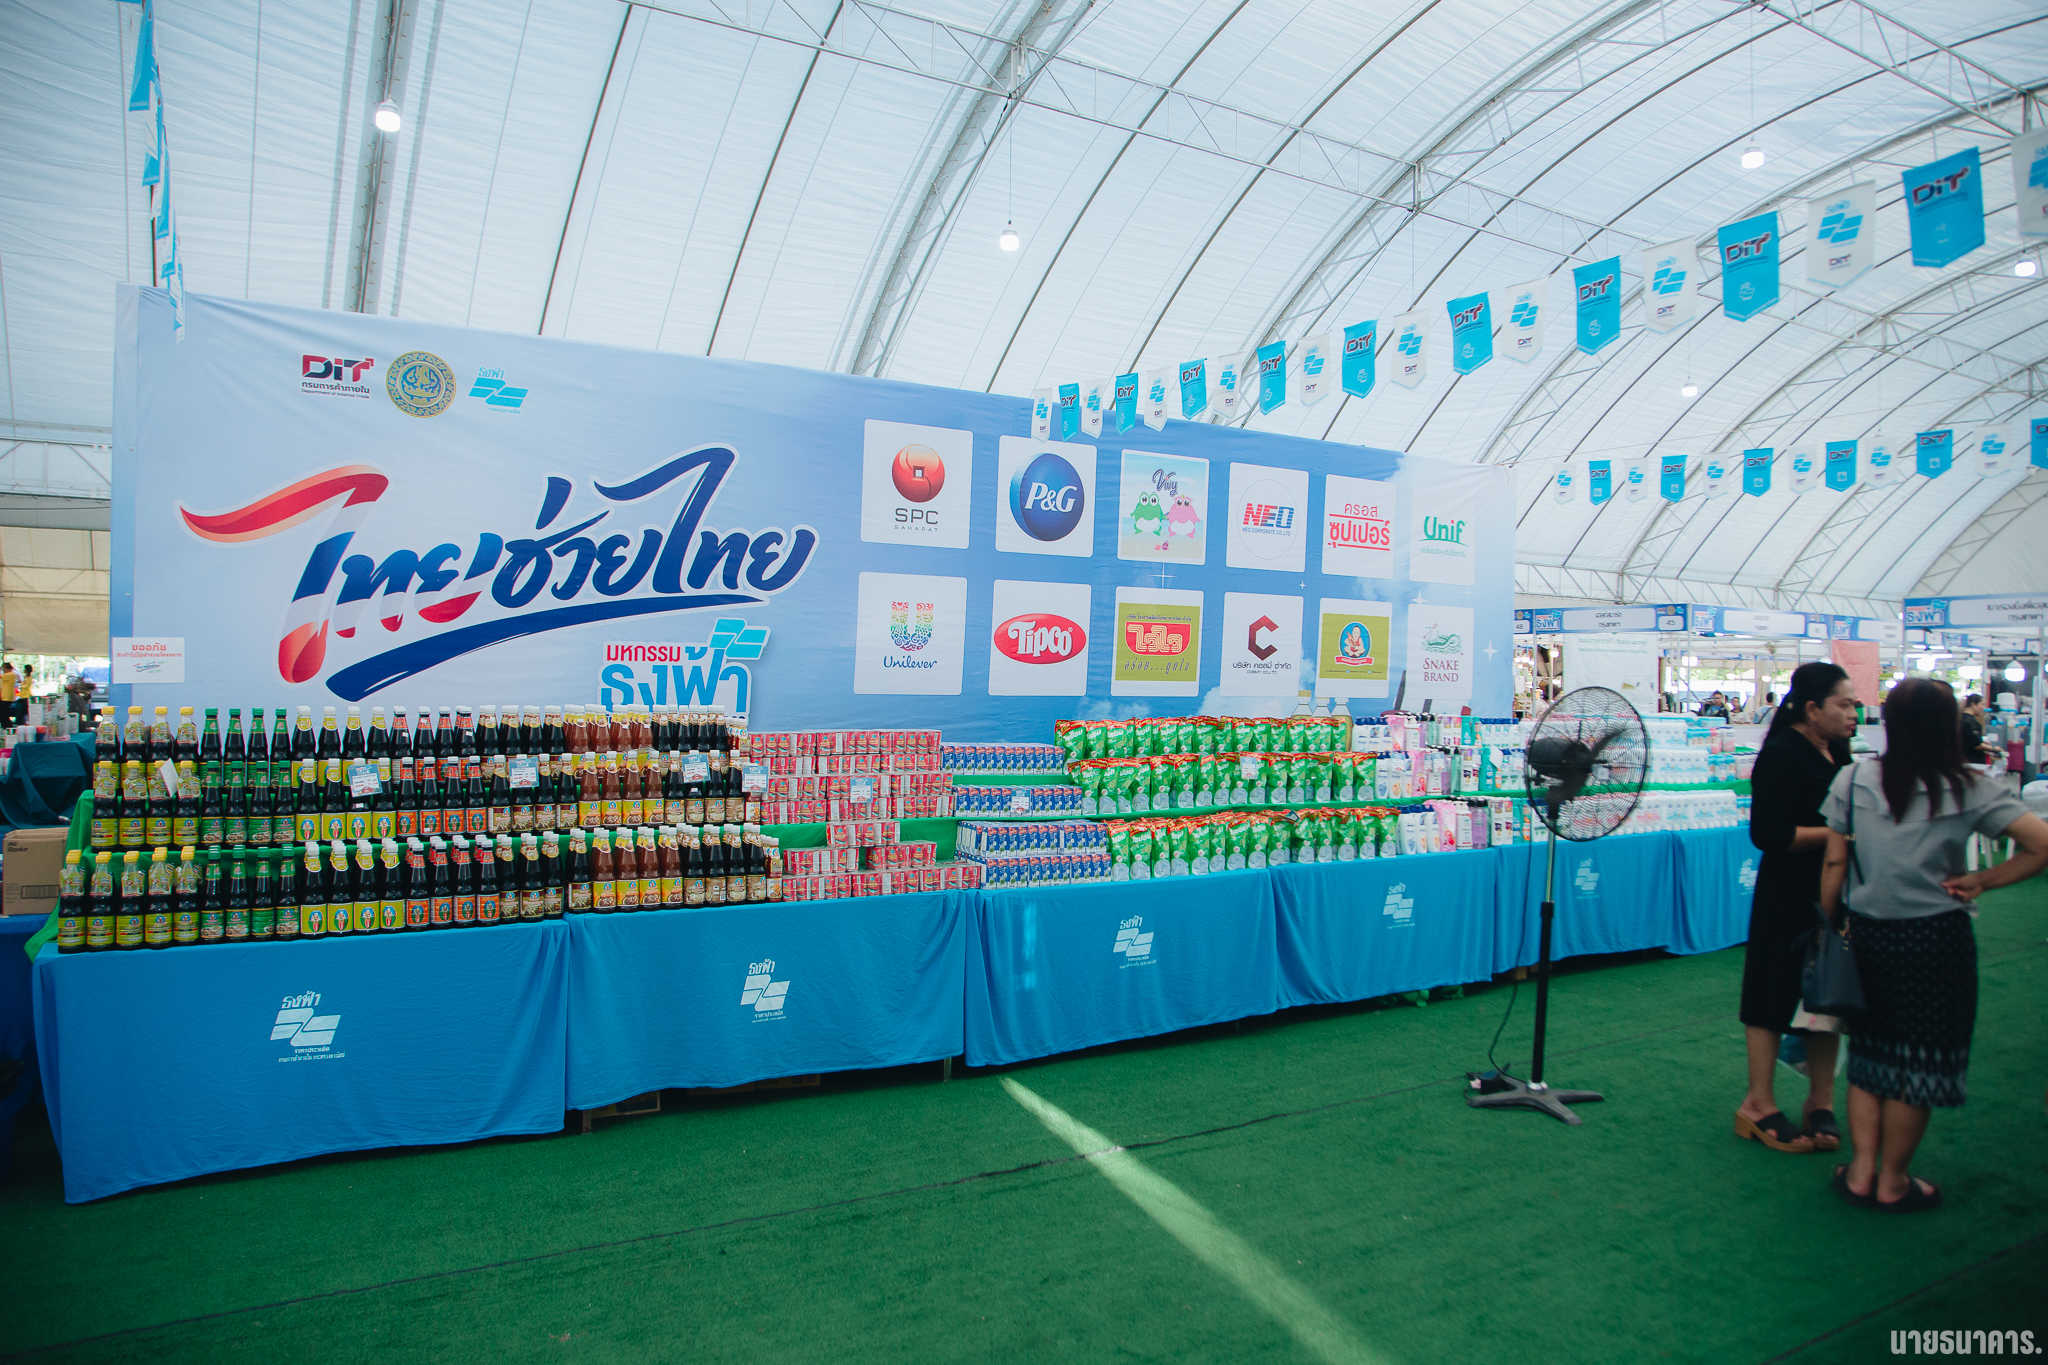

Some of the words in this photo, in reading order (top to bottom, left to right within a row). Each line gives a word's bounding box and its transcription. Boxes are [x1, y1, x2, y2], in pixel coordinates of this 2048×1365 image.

[302, 355, 374, 382] DiT
[301, 381, 370, 393] กรมการค้าภายใน
[1024, 481, 1078, 513] P&G
[895, 507, 938, 525] SPC
[1243, 502, 1295, 529] NEO
[1344, 503, 1378, 517] ครอส
[895, 524, 938, 532] SAHAPAT
[1329, 520, 1390, 548] ซุปเปอร์
[1423, 515, 1465, 543] Unif
[180, 447, 816, 684] ไทยช่วยไทย
[132, 642, 167, 651] ขออภัย
[1008, 620, 1074, 657] Tipco
[606, 644, 681, 663] มหกรรม
[883, 655, 938, 668] Unilever
[1232, 661, 1252, 669] บริษัท
[1274, 661, 1292, 669] จำกัด
[1422, 657, 1459, 670] SNAKE
[601, 646, 748, 713] ธงฟ้า
[1423, 671, 1459, 682] BRAND
[1119, 914, 1143, 929] ธงฟ้า
[749, 958, 776, 975] ธงฟ้า
[281, 990, 321, 1009] ธงฟ้า
[294, 1045, 330, 1054] ราคาประหยัด
